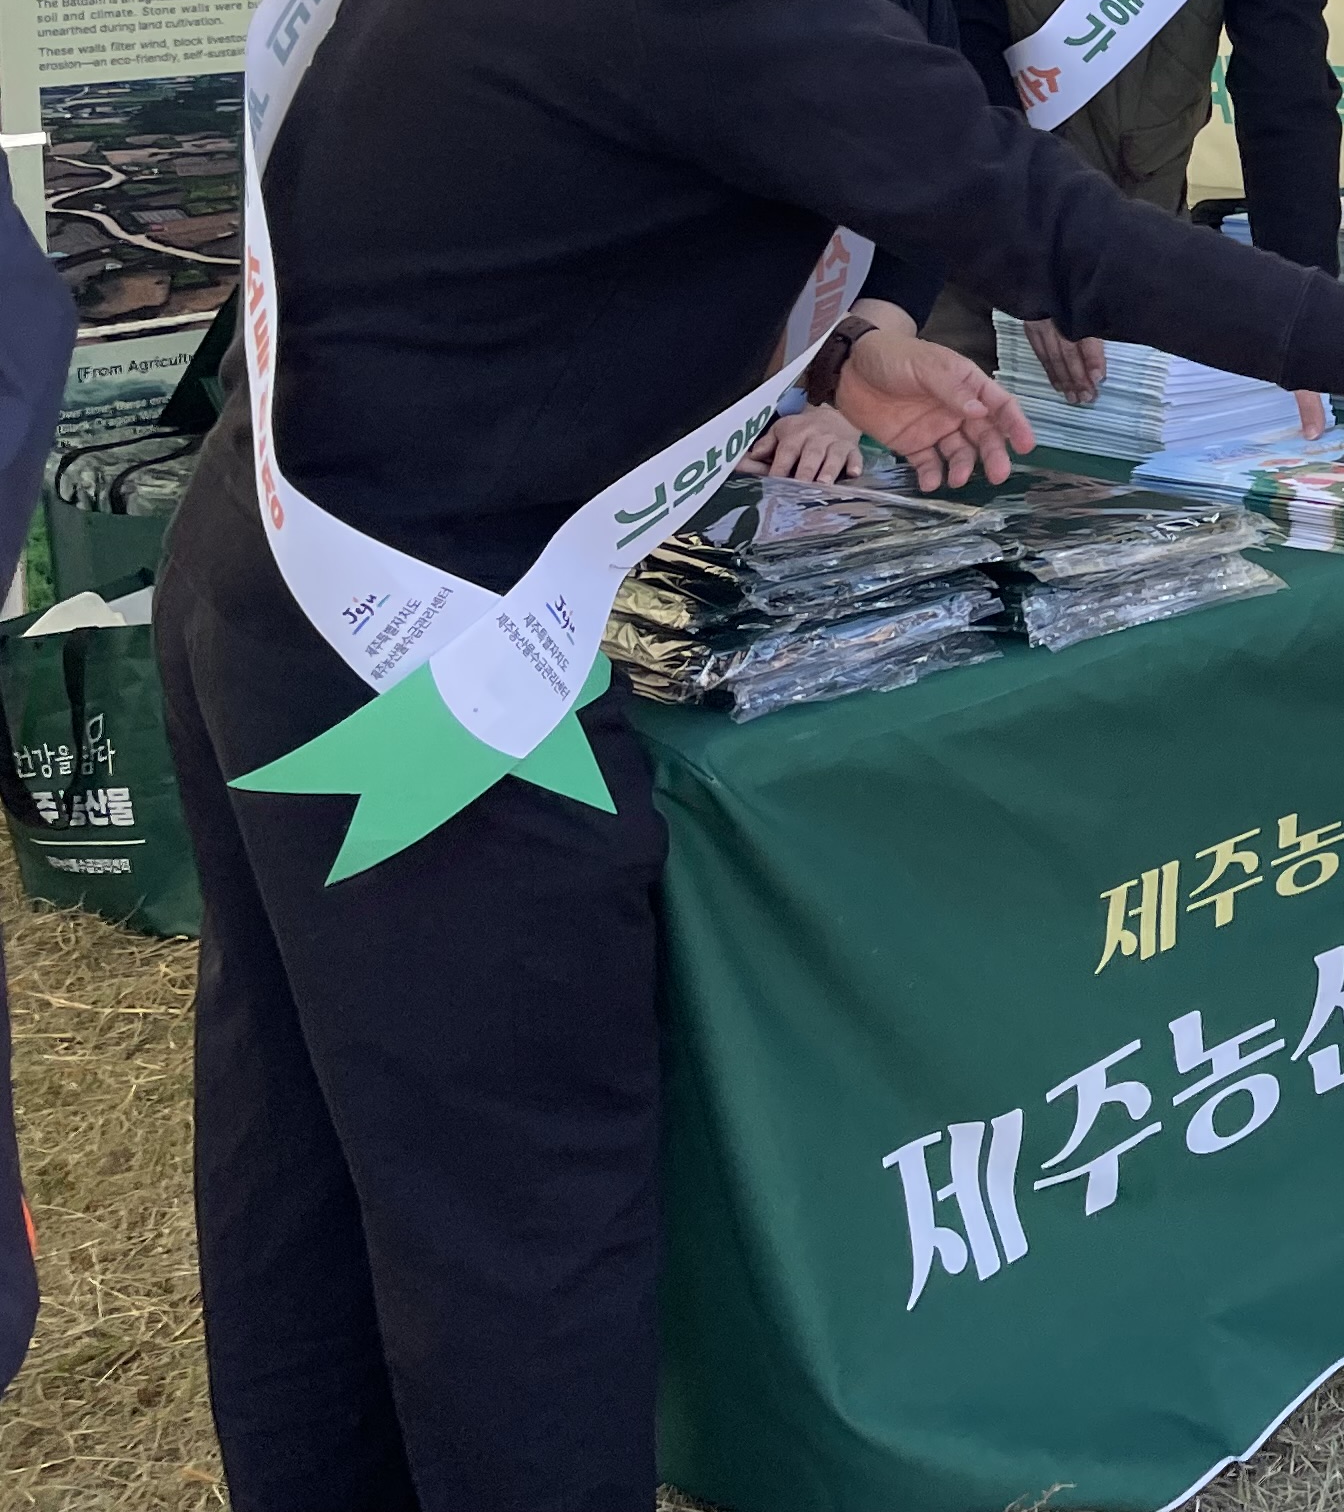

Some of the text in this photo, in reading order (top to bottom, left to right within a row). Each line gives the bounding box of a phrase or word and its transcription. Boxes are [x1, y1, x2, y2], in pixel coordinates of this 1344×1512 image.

[36, 12, 58, 24] soil
[62, 10, 85, 22] and
[142, 6, 176, 17] Stone
[37, 24, 98, 38] unearthed
[99, 21, 136, 35] during
[137, 19, 163, 31] land
[38, 46, 75, 59] These
[342, 593, 378, 626] Jeju
[364, 597, 423, 659] 제주특별자치도
[554, 594, 577, 635] Jeju
[369, 585, 455, 681] 제주농산물수급관리센터
[523, 611, 571, 673] 제주특별자치도
[495, 611, 572, 702] 제주농산물수급관리센터
